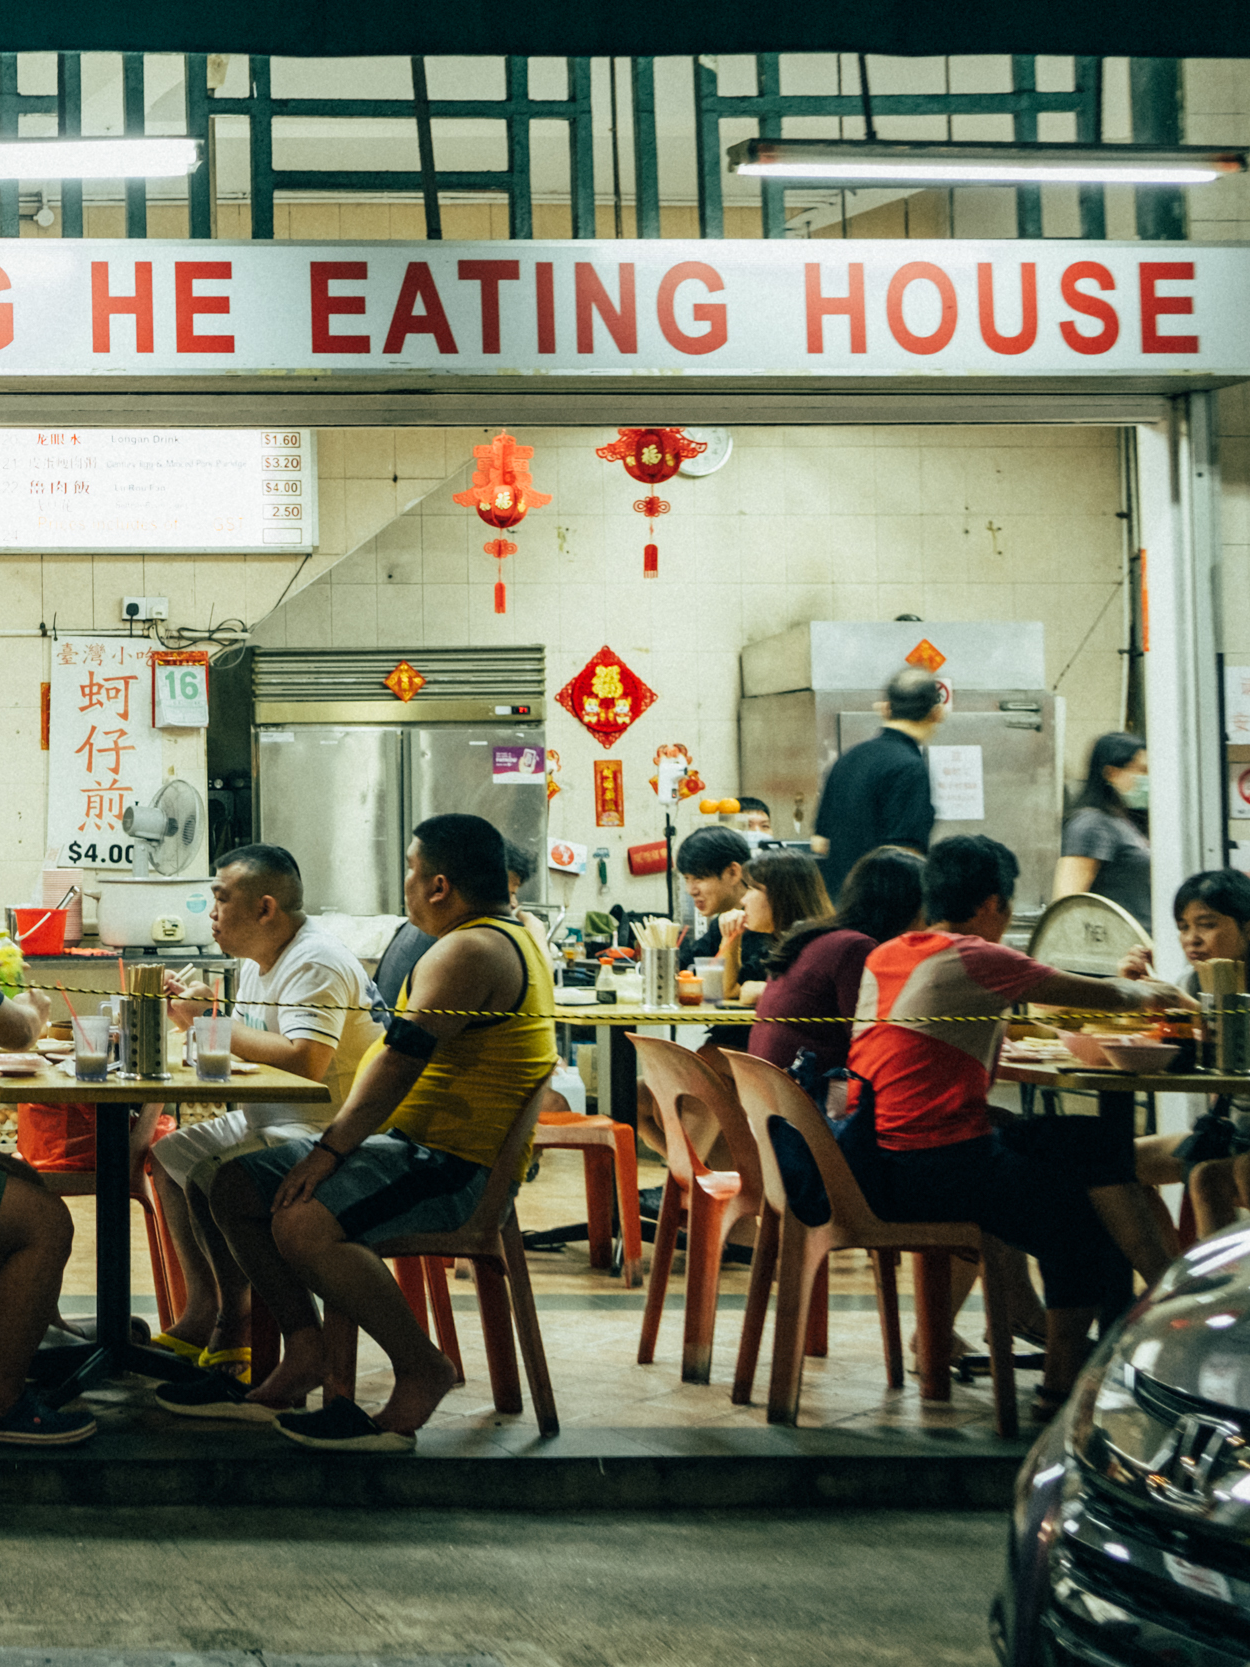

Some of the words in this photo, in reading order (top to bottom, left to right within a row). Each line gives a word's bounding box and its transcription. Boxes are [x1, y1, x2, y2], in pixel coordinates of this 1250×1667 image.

[90, 261, 235, 354] HE
[309, 259, 729, 356] EATING
[805, 260, 1200, 356] HOUSE
[152, 435, 180, 444] Drink
[263, 433, 298, 446] $1.60
[264, 457, 299, 469] $3.20
[264, 481, 299, 493] $4.00
[165, 671, 199, 700] 16
[74, 670, 139, 832] 蚵仔煎
